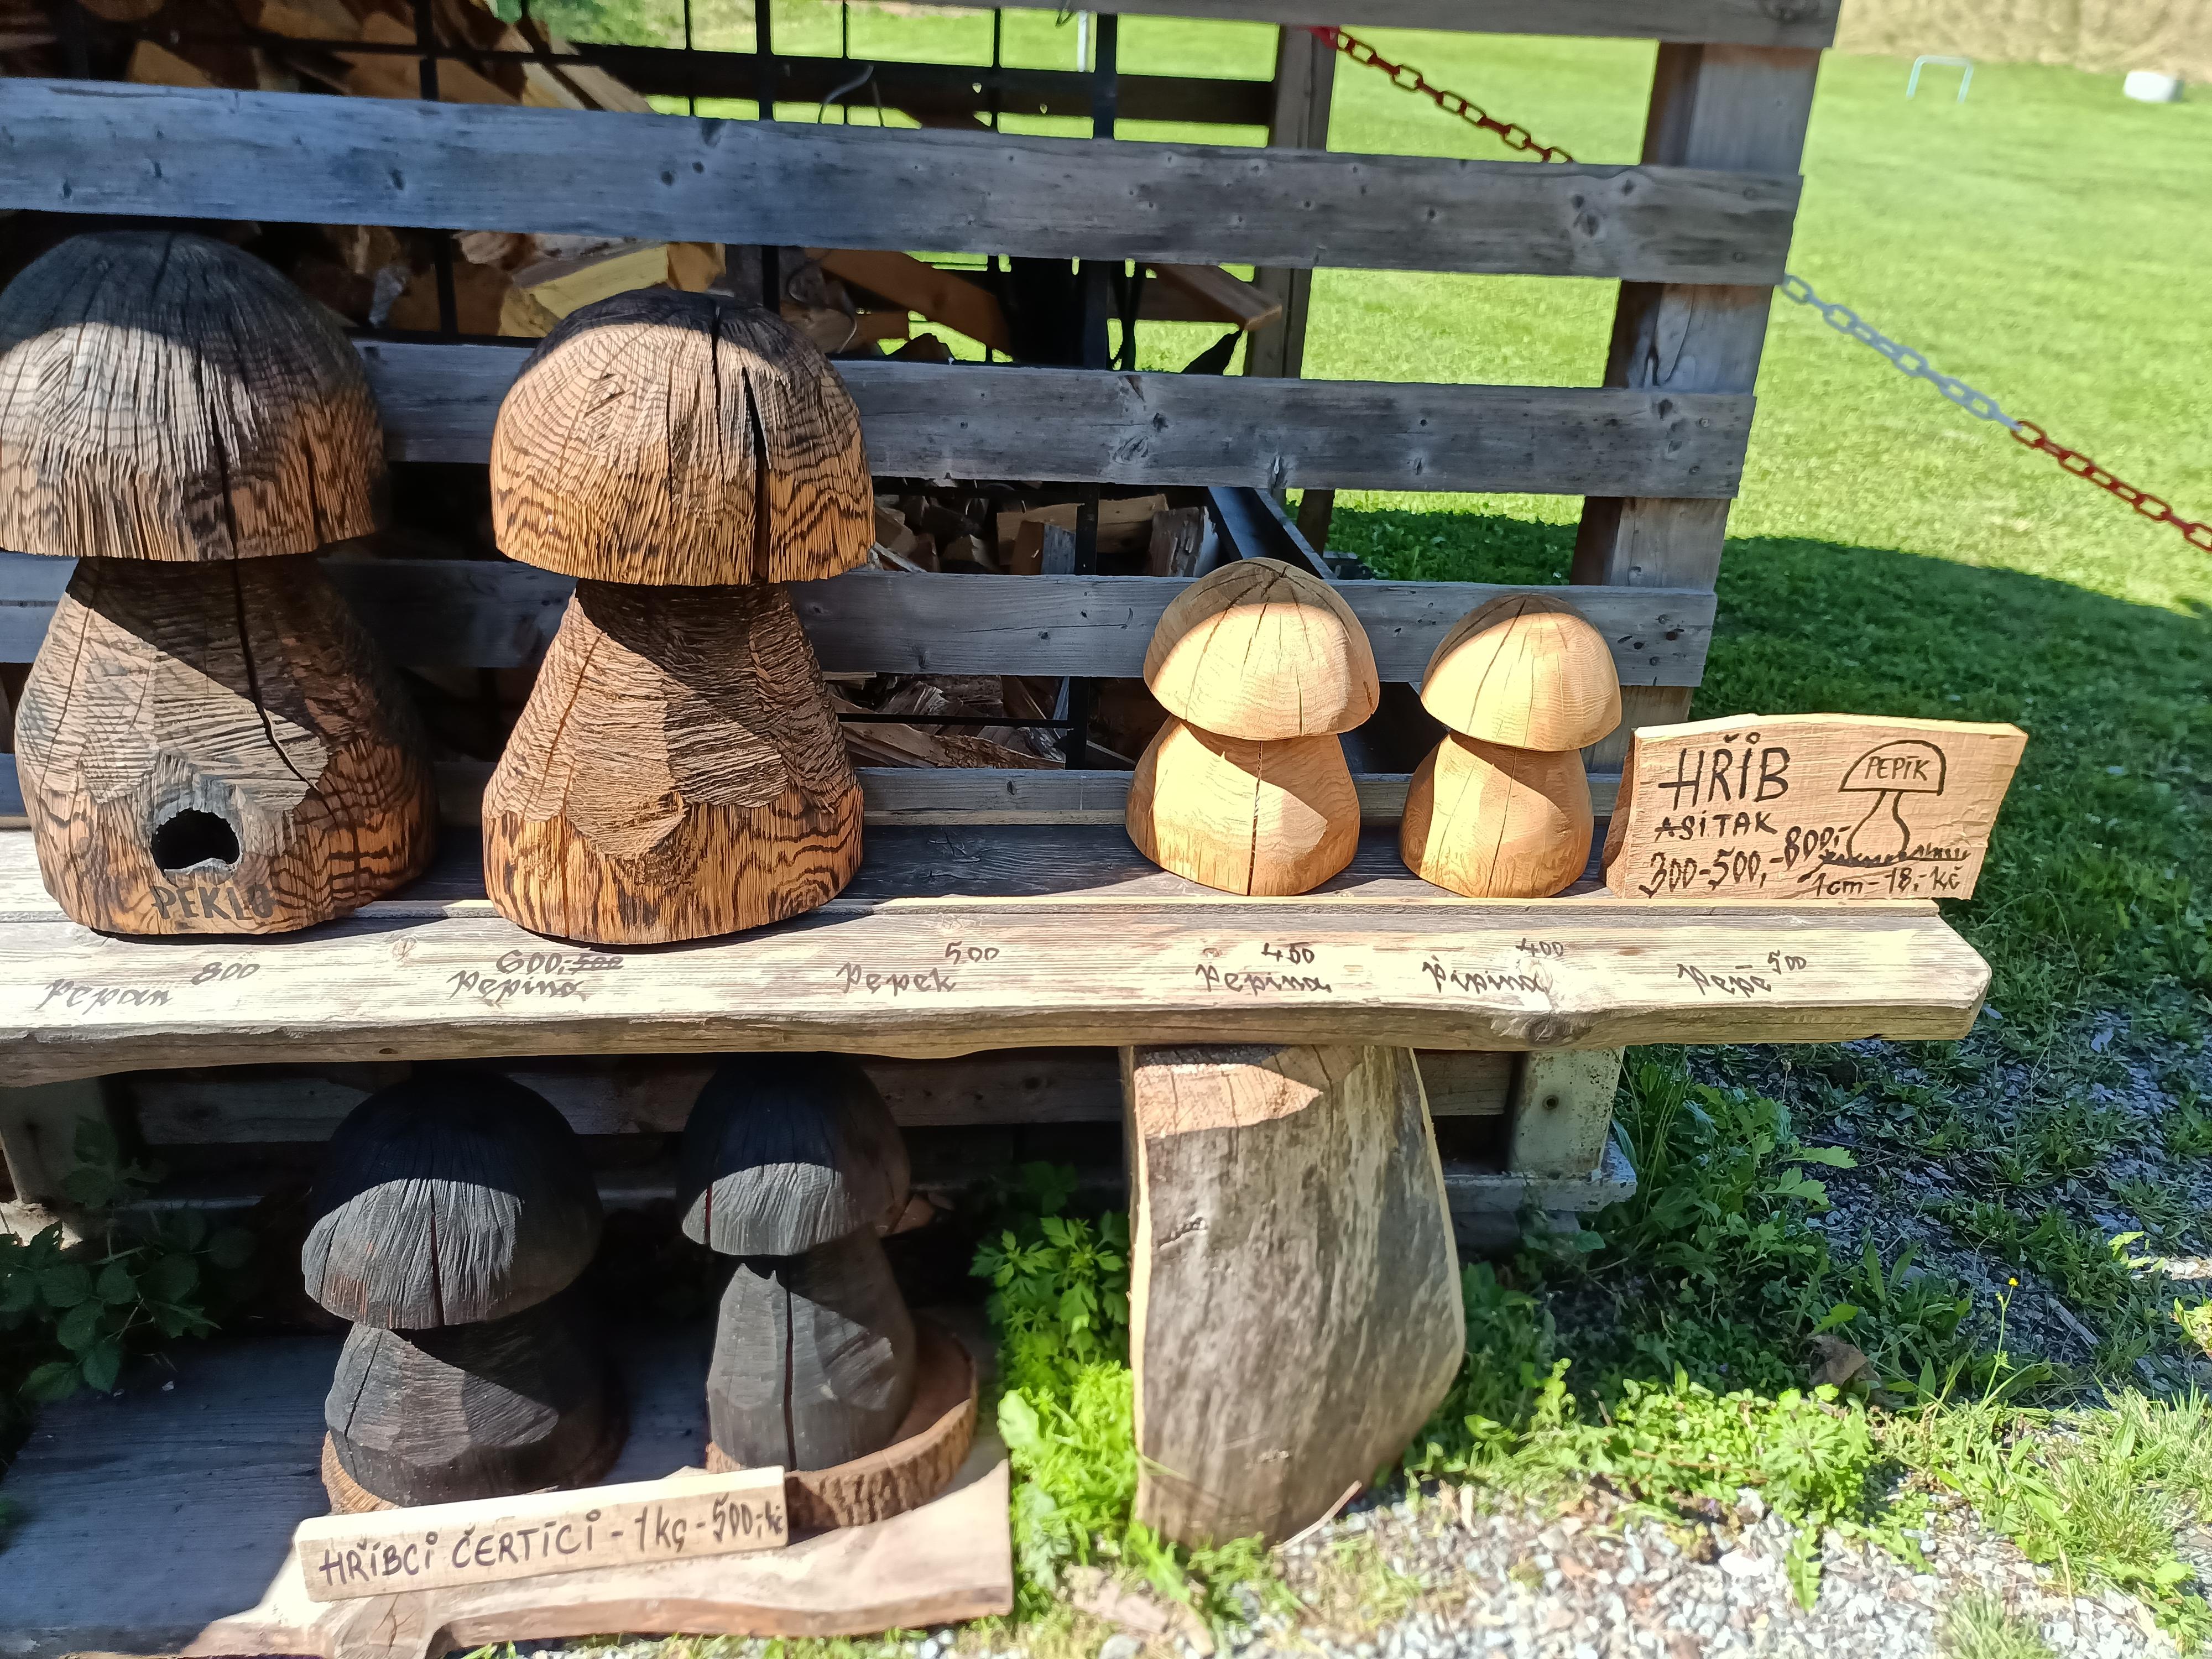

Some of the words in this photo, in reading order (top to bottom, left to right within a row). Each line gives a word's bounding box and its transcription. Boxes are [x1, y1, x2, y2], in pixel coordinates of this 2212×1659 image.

[945, 941, 999, 964] 500
[1515, 937, 1564, 957] 400
[191, 962, 260, 985] 800
[1767, 950, 1807, 975] 500
[836, 962, 956, 997] Pepek
[1195, 964, 1333, 997] Pepina
